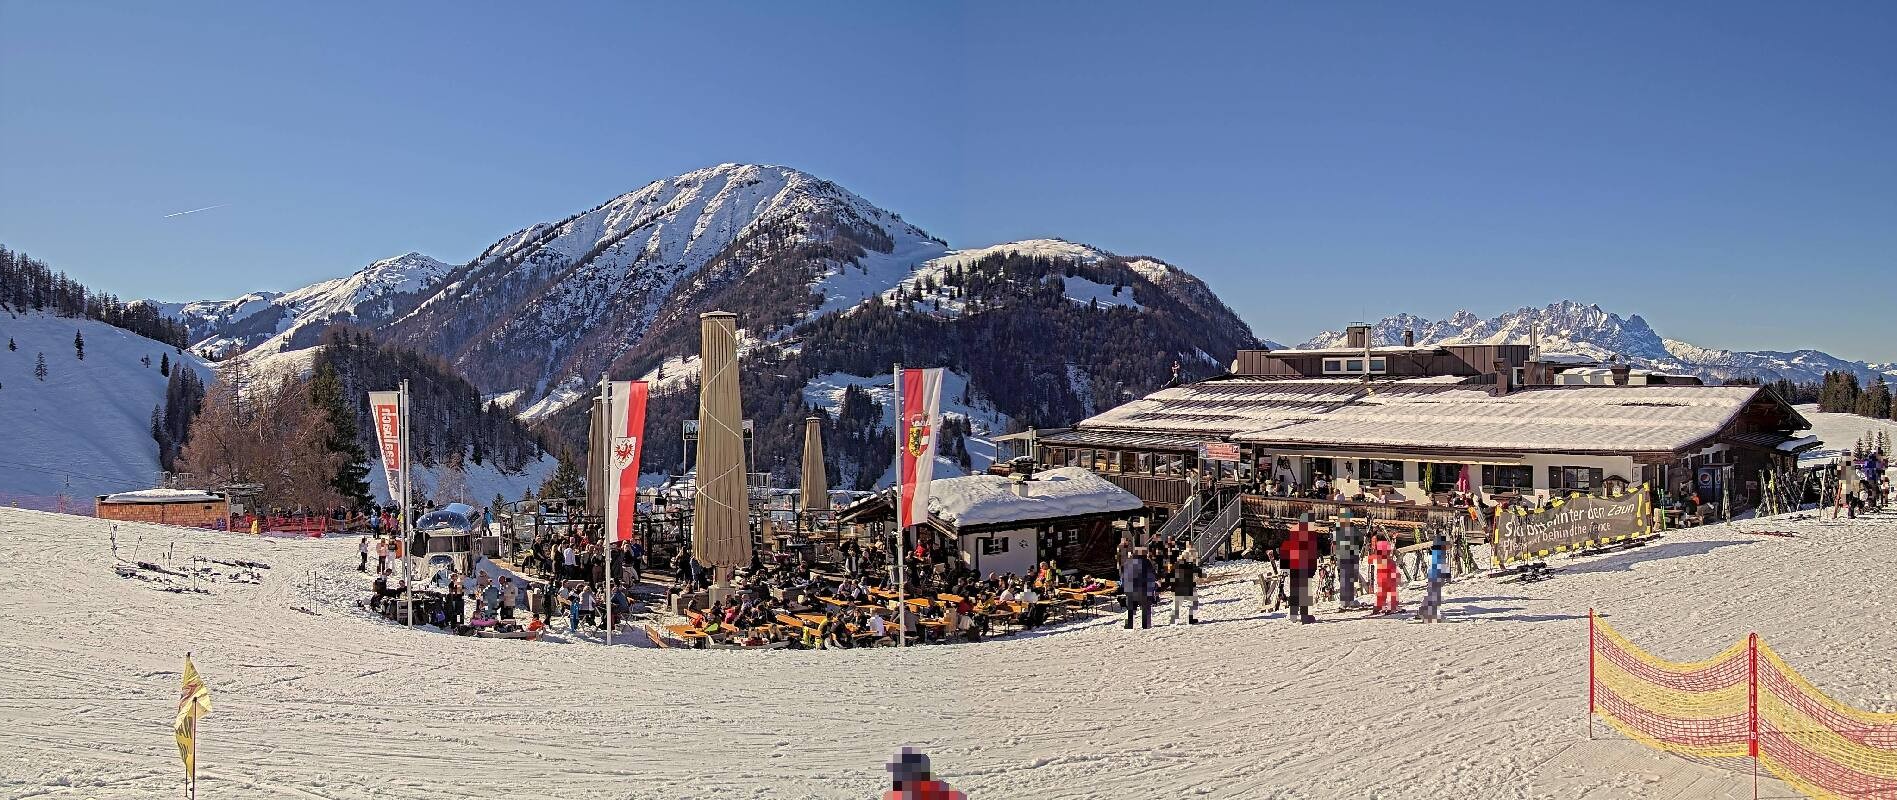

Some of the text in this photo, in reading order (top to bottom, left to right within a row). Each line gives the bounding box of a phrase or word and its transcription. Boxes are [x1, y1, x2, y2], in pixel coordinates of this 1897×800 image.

[1504, 520, 1524, 537] Ski
[1588, 504, 1604, 520] den
[1607, 503, 1635, 517] Zaun
[1542, 523, 1574, 541] behind
